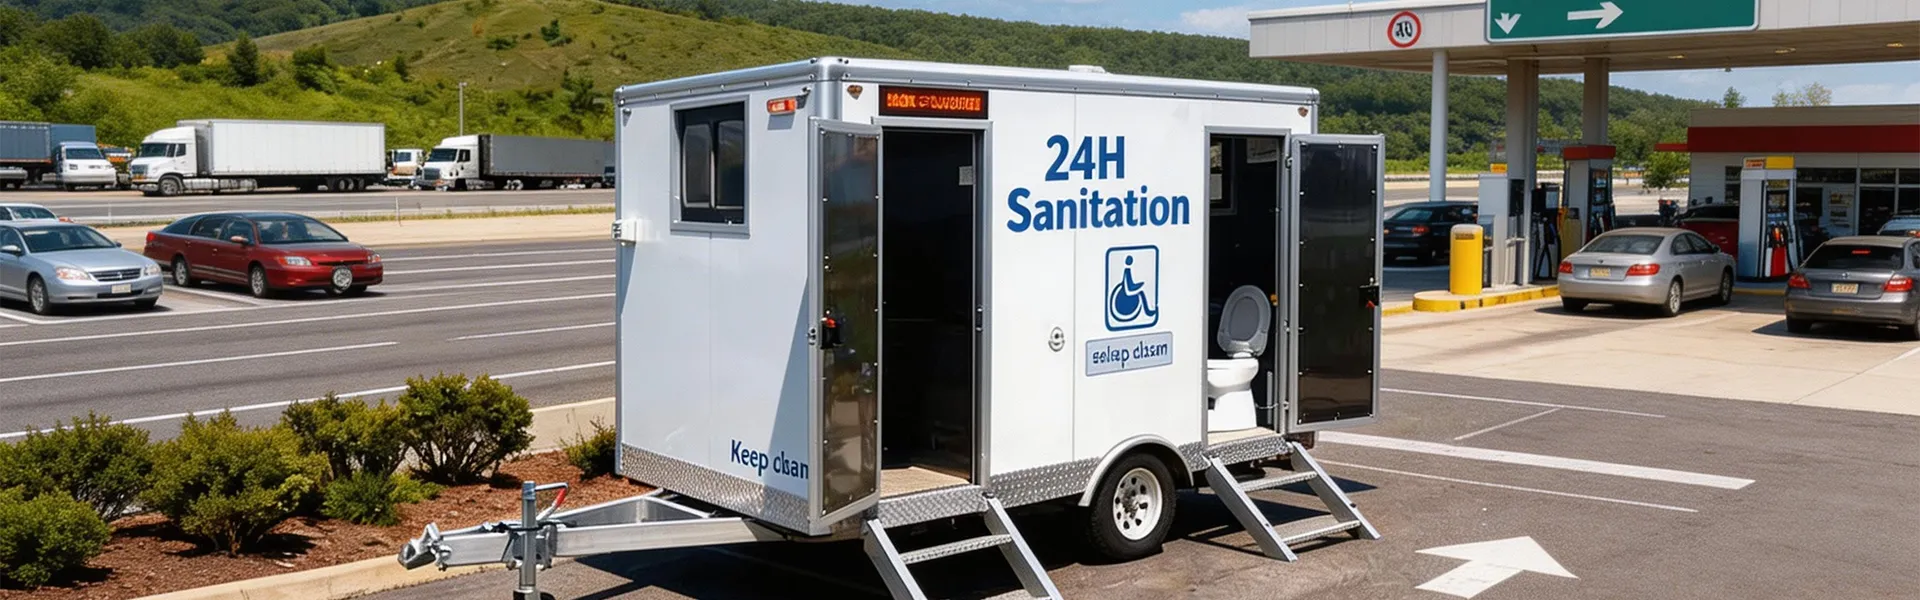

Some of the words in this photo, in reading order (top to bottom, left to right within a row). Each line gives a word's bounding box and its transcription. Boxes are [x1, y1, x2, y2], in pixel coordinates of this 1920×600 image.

[1045, 134, 1125, 181] 24H
[1007, 185, 1190, 233] Sanitation
[731, 439, 769, 477] Keep
